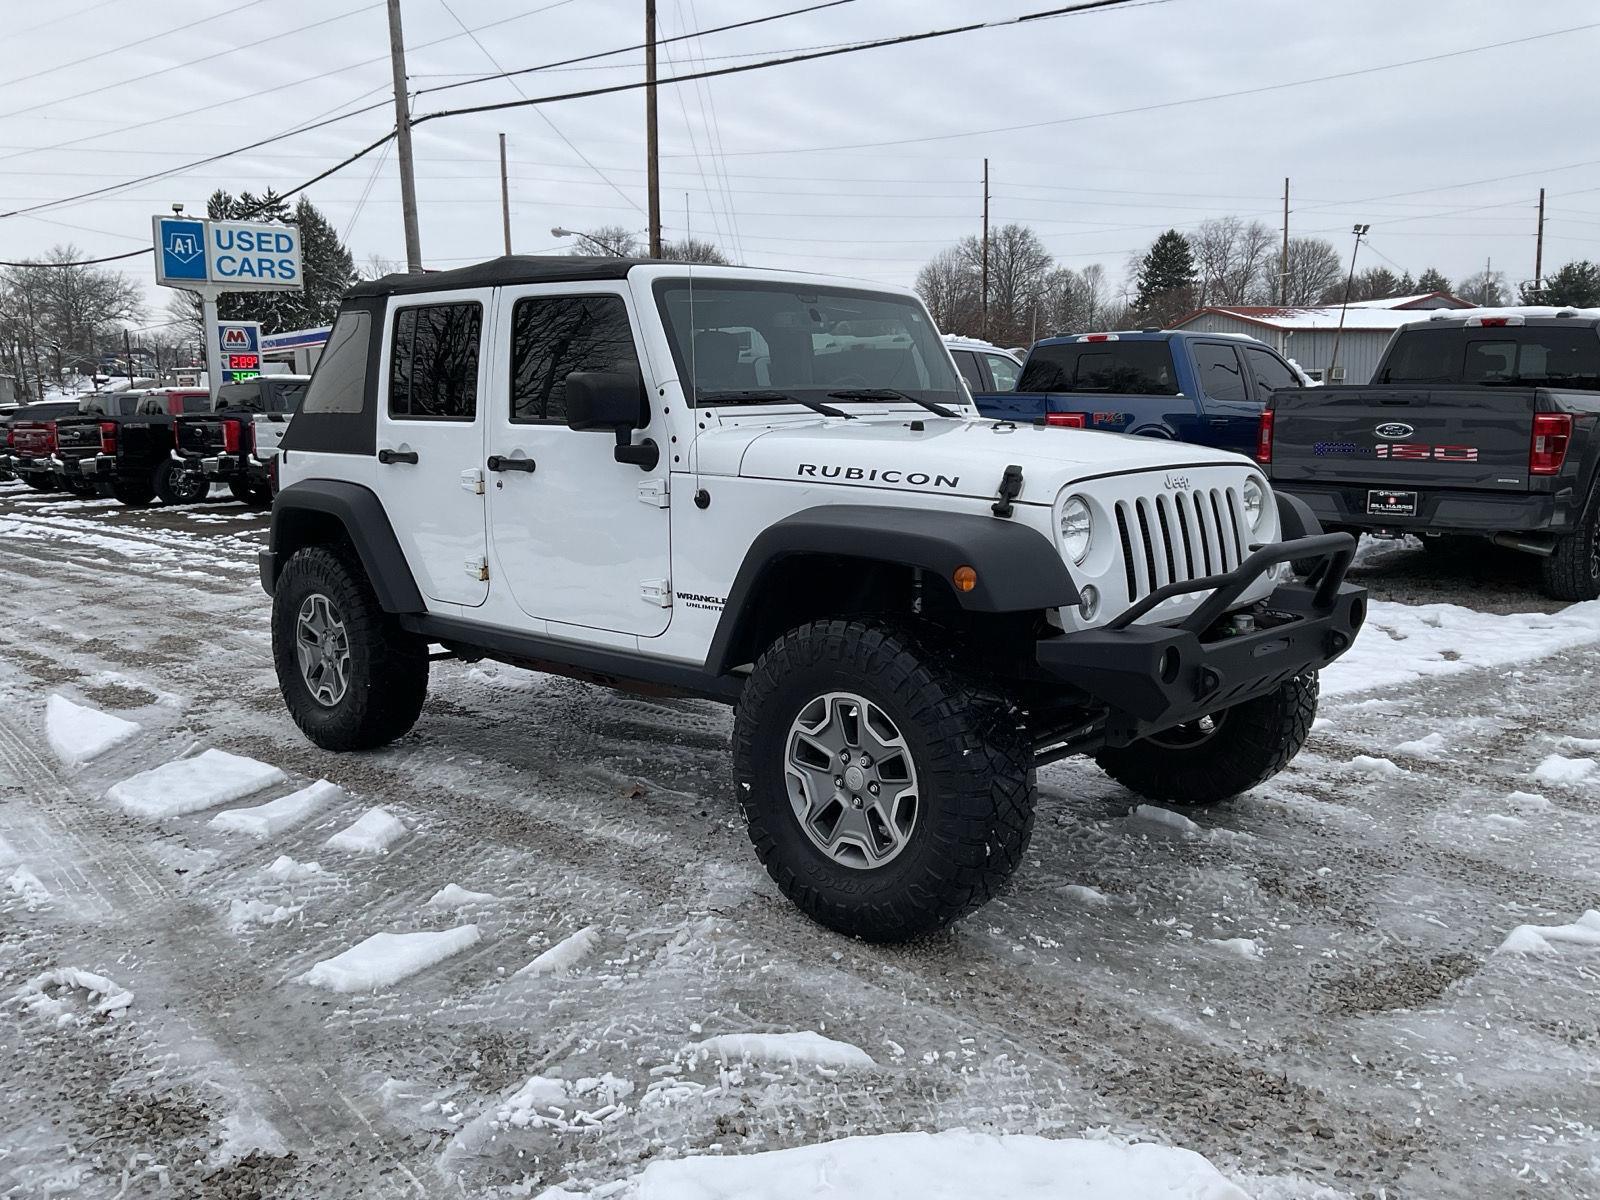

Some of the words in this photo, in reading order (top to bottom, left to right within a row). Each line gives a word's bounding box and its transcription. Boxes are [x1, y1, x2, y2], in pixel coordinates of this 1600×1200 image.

[174, 238, 193, 254] A-1
[215, 229, 294, 253] USED
[216, 255, 296, 279] CARS
[226, 330, 246, 342] M
[1093, 412, 1125, 424] FX4
[797, 463, 960, 488] RUBICON
[1164, 474, 1191, 490] Jeep
